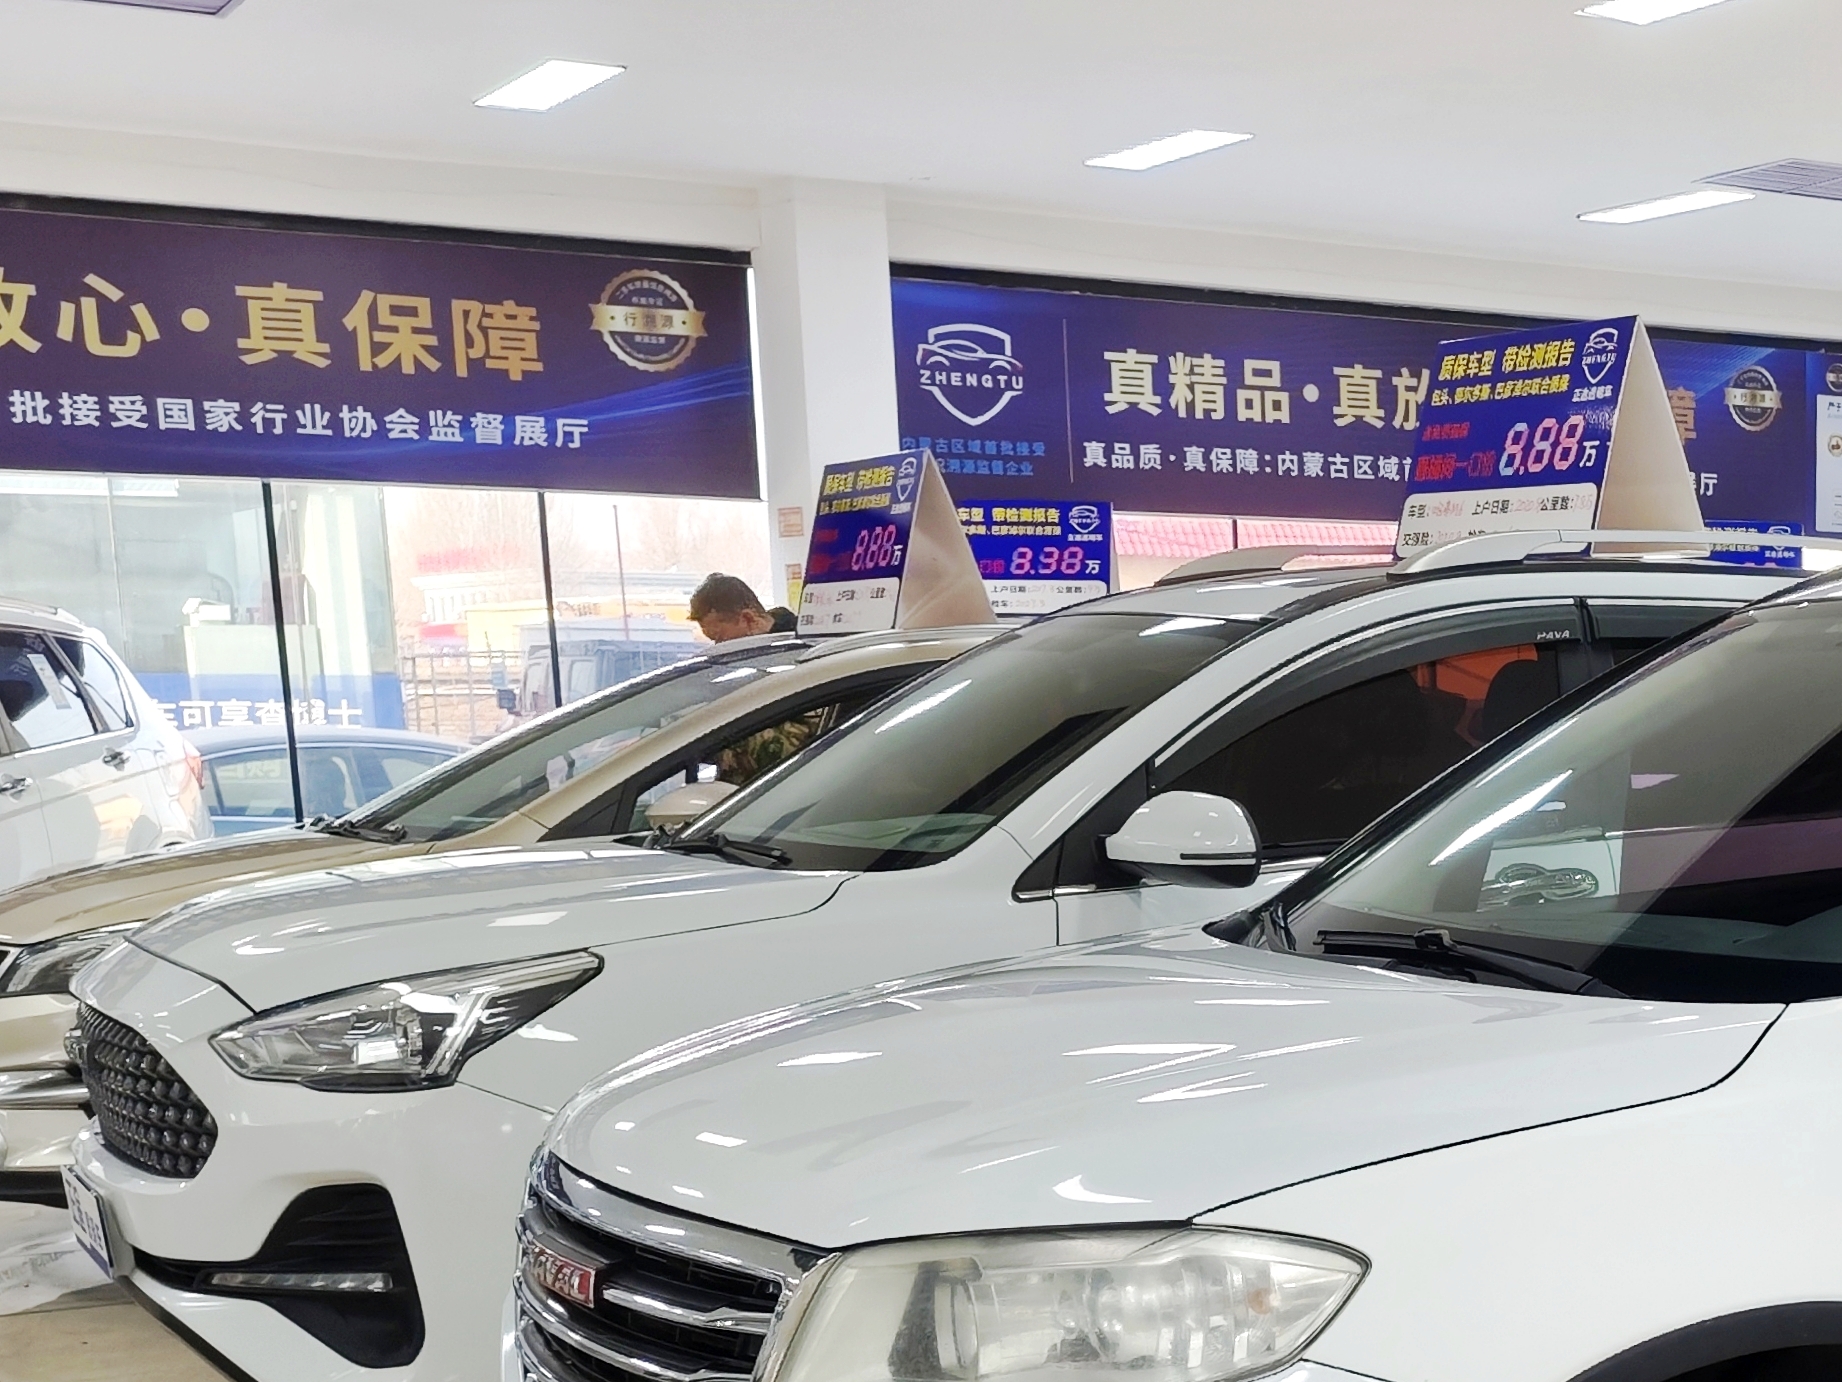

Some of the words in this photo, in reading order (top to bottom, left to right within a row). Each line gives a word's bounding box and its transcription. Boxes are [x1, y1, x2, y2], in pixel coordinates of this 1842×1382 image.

[1501, 339, 1575, 373] 带检测报告
[919, 369, 1024, 390] ZHENGTU
[9, 389, 590, 449] 批接受国家行业协会监督展厅
